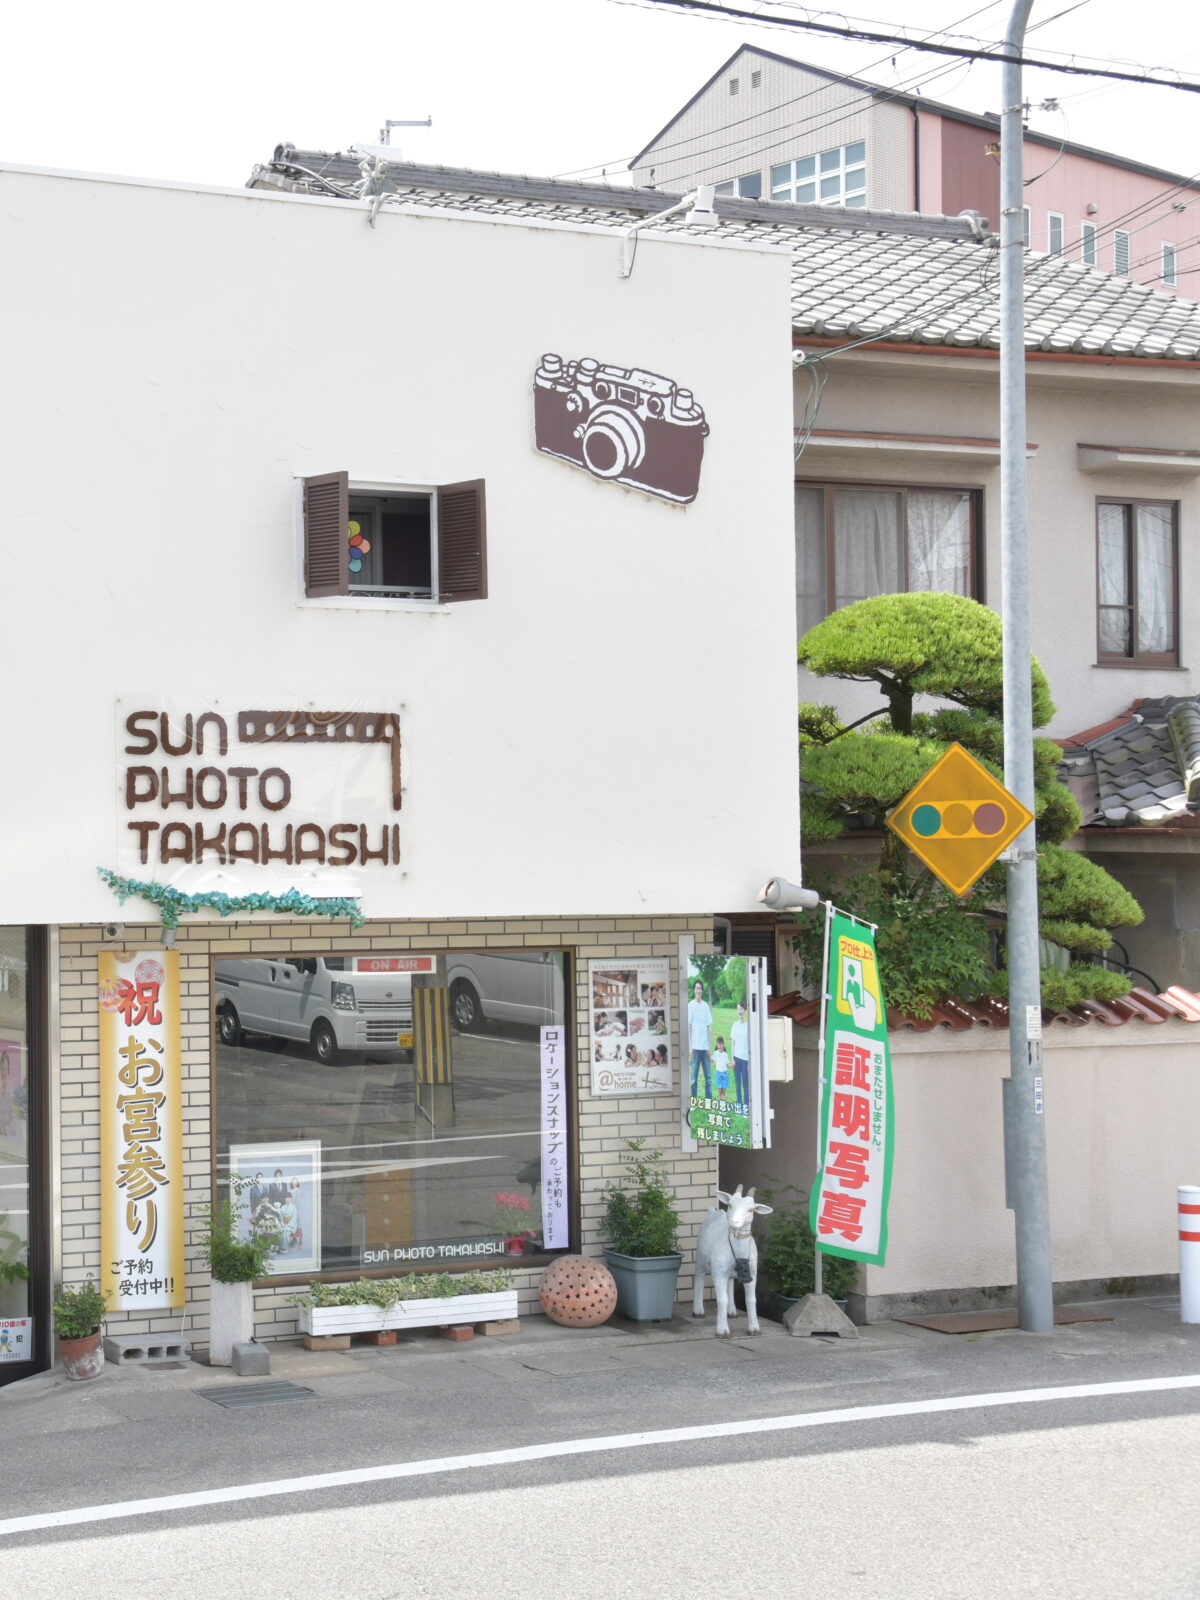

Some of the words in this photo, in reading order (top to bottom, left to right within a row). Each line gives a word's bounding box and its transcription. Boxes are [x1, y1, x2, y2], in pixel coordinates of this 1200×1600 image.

[125, 710, 228, 756] SUN
[125, 765, 291, 812] PHOTO
[127, 821, 401, 866] TAKAHASHI
[371, 960, 390, 971] ON
[397, 959, 419, 970] AIR
[117, 979, 163, 1027] 祝
[690, 1096, 749, 1118] ひと夏の思い出を
[708, 1113, 731, 1128] 写真で
[872, 1053, 883, 1152] おまたせしません。
[115, 1034, 170, 1253] お宮参り
[697, 1127, 743, 1146] 残しましょう
[817, 1042, 871, 1243] 証明写真
[111, 1258, 153, 1275] ご予約
[364, 1250, 389, 1263] SUN
[394, 1246, 435, 1260] PHOTO
[438, 1242, 505, 1257] TAKAHASHI
